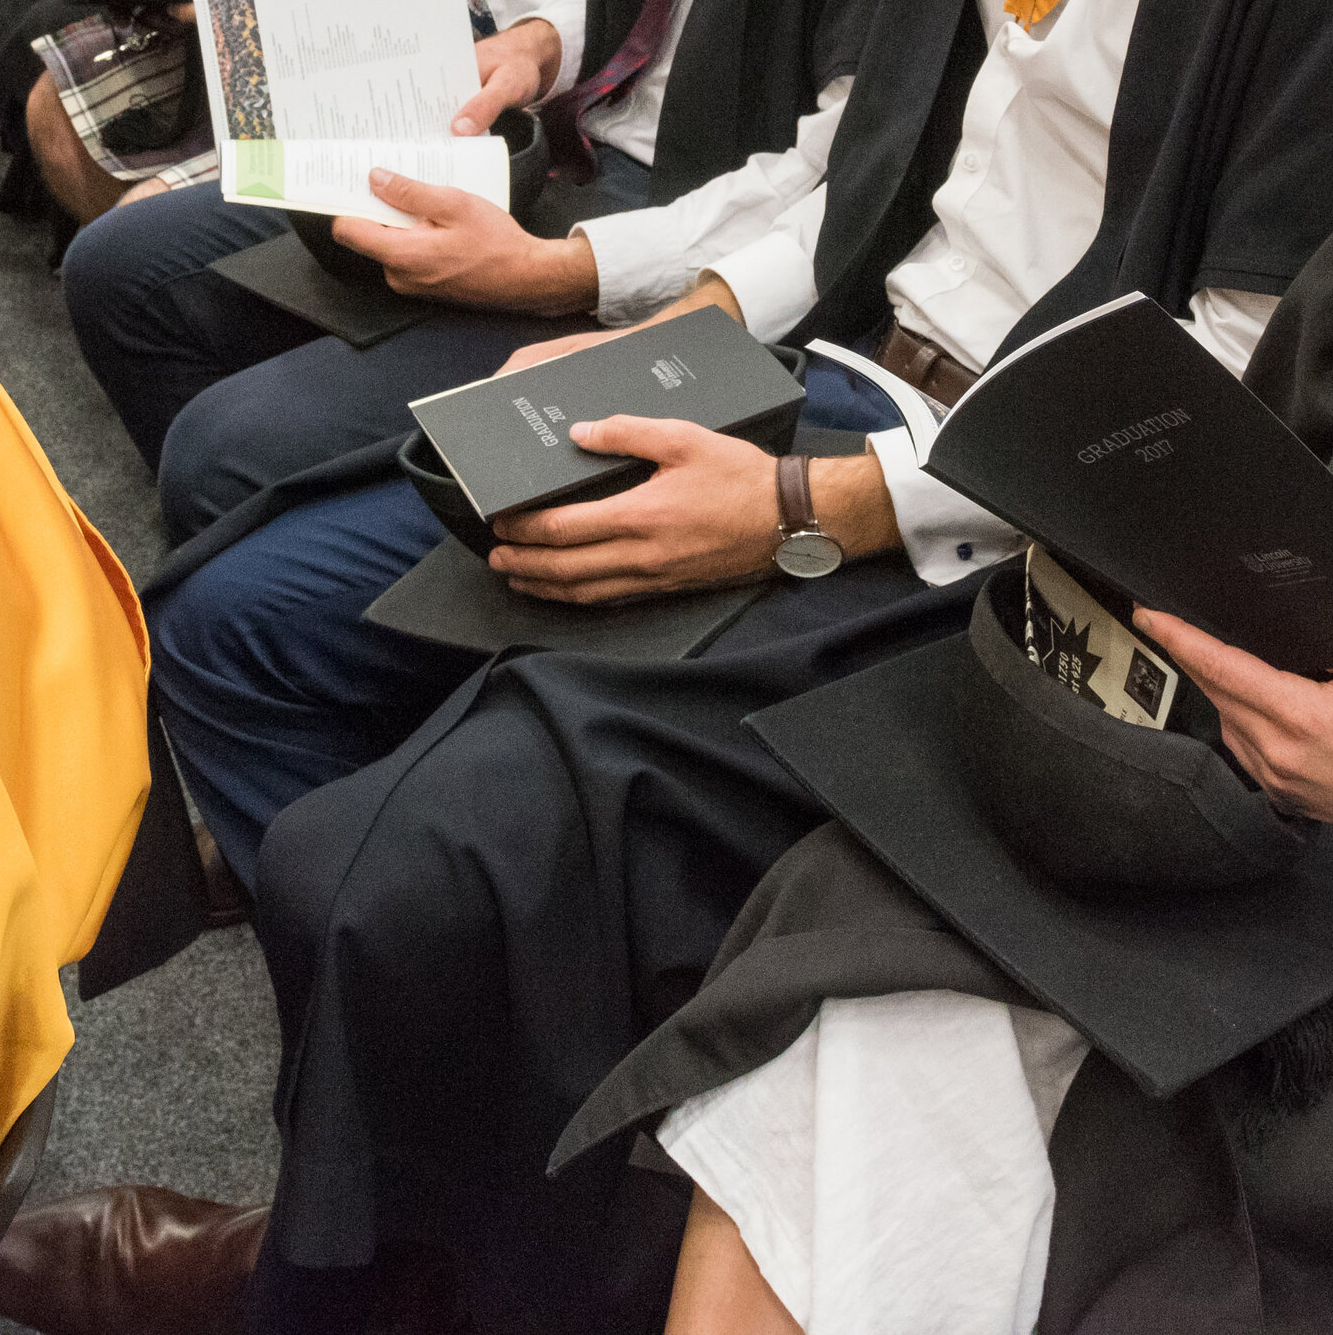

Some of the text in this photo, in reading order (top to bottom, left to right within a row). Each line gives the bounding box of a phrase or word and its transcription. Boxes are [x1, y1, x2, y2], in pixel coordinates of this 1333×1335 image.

[512, 397, 558, 447] GRADUATION
[543, 406, 566, 423] 2017
[1077, 408, 1192, 464] GRADUATION
[1134, 439, 1174, 463] 2017
